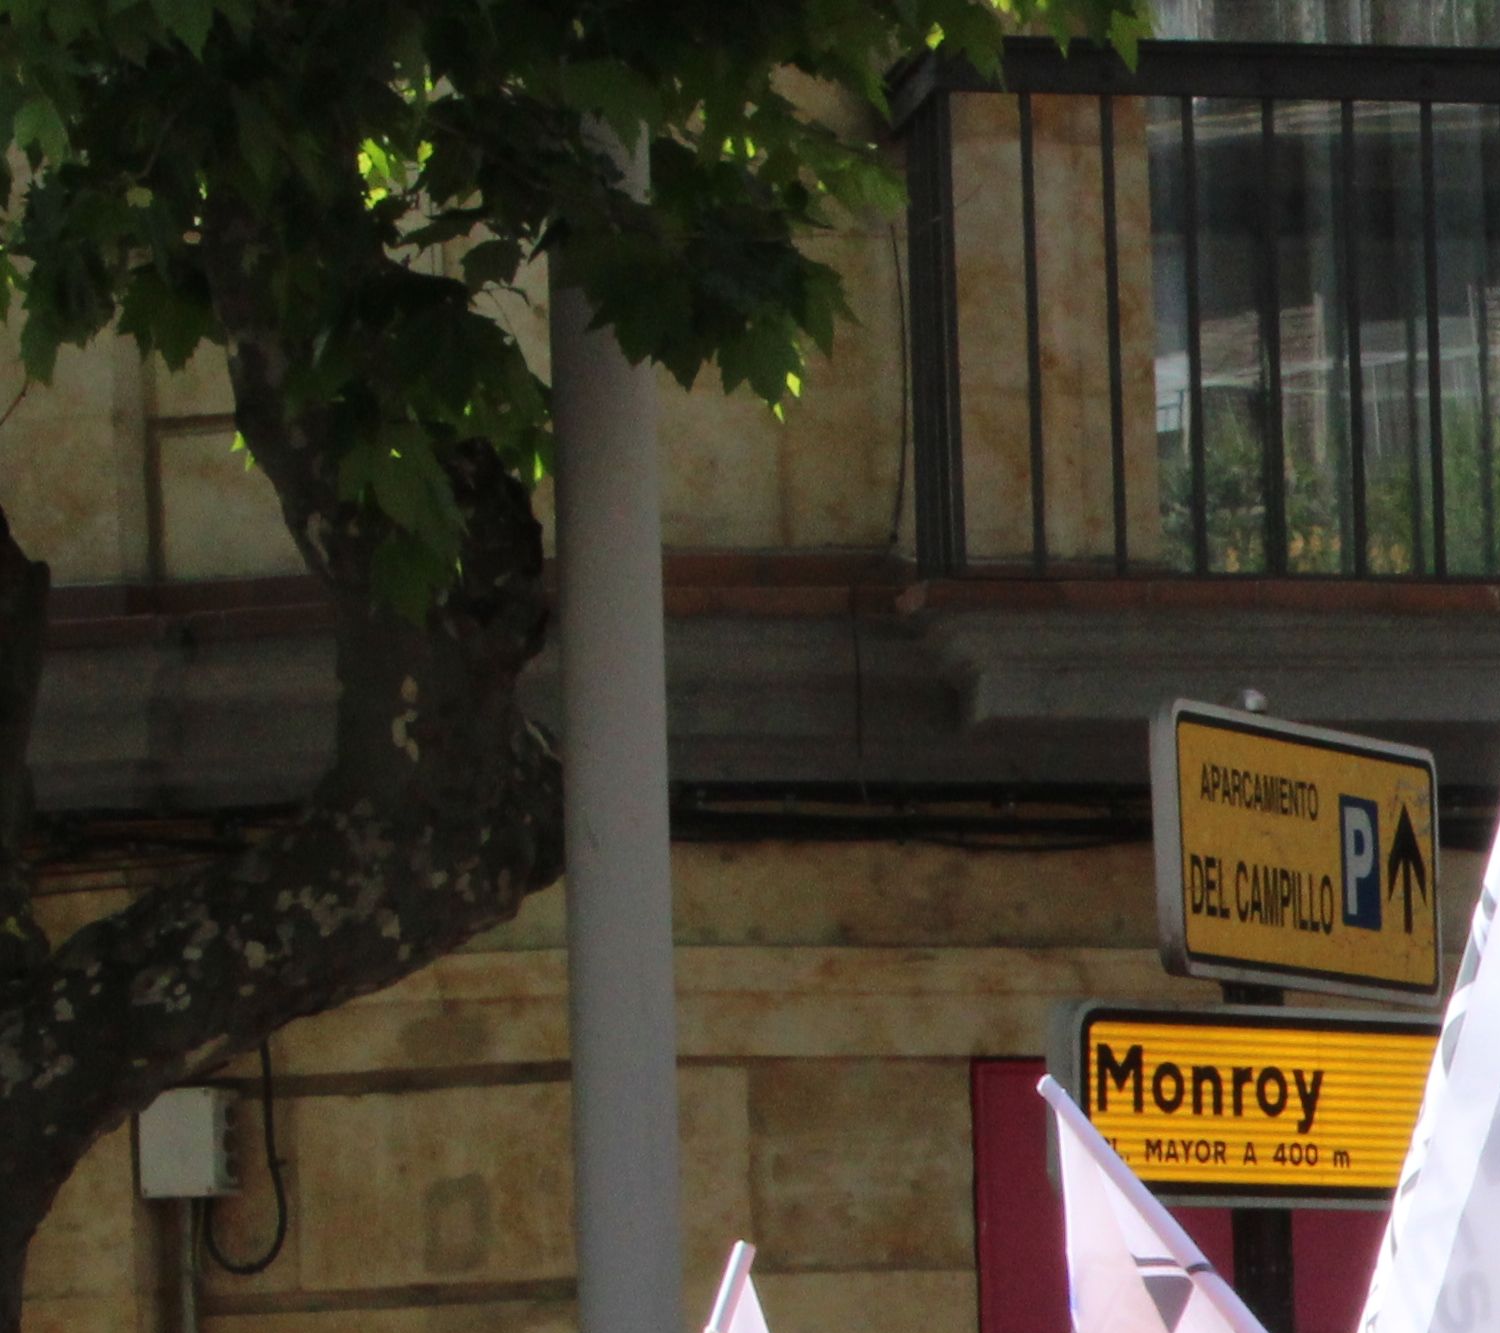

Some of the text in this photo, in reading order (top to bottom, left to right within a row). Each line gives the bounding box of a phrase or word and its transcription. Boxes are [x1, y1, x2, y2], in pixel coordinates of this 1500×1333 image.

[1200, 763, 1319, 821] APARCAMIENTO
[1190, 853, 1334, 936] DEL CAMPILLO
[1096, 1042, 1325, 1135] Monroy
[1144, 1138, 1228, 1165] MAYOR
[1243, 1142, 1258, 1165] A
[1273, 1142, 1319, 1167] 400
[1332, 1149, 1351, 1168] m
